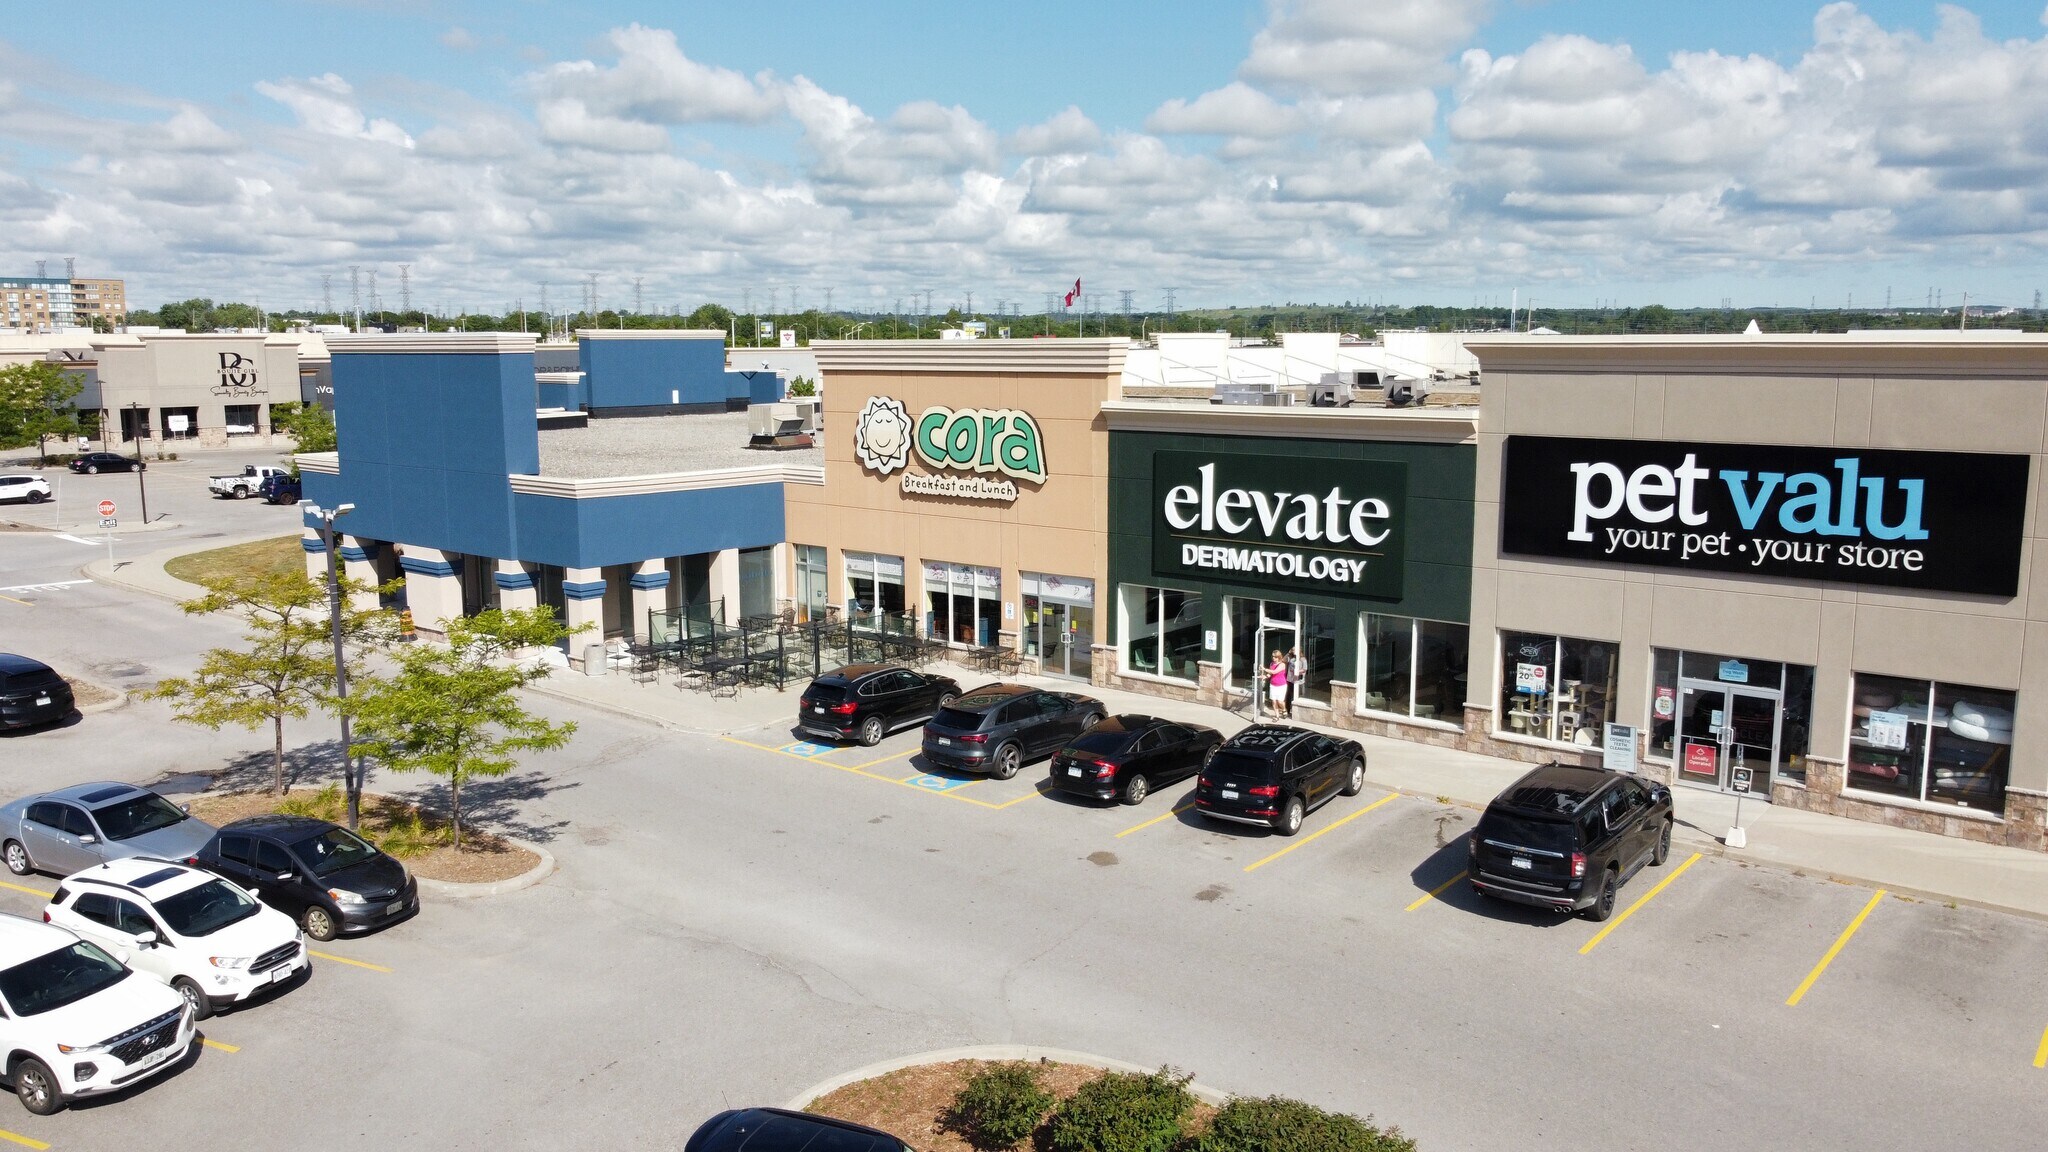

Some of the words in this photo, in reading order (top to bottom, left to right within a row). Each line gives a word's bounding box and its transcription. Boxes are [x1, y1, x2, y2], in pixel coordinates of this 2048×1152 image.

[918, 412, 1040, 474] cora
[904, 475, 956, 491] Breakfast
[960, 482, 978, 493] and
[981, 483, 1013, 496] Lunch
[1164, 462, 1390, 546] elevate
[1567, 453, 1710, 542] pet
[1719, 457, 1929, 541] valu
[100, 504, 114, 512] STOP
[1182, 543, 1367, 583] DERMATOLOGY
[1605, 527, 1675, 554] your
[1681, 531, 1731, 560] pet
[1751, 537, 1831, 566] your
[1838, 540, 1924, 571] store
